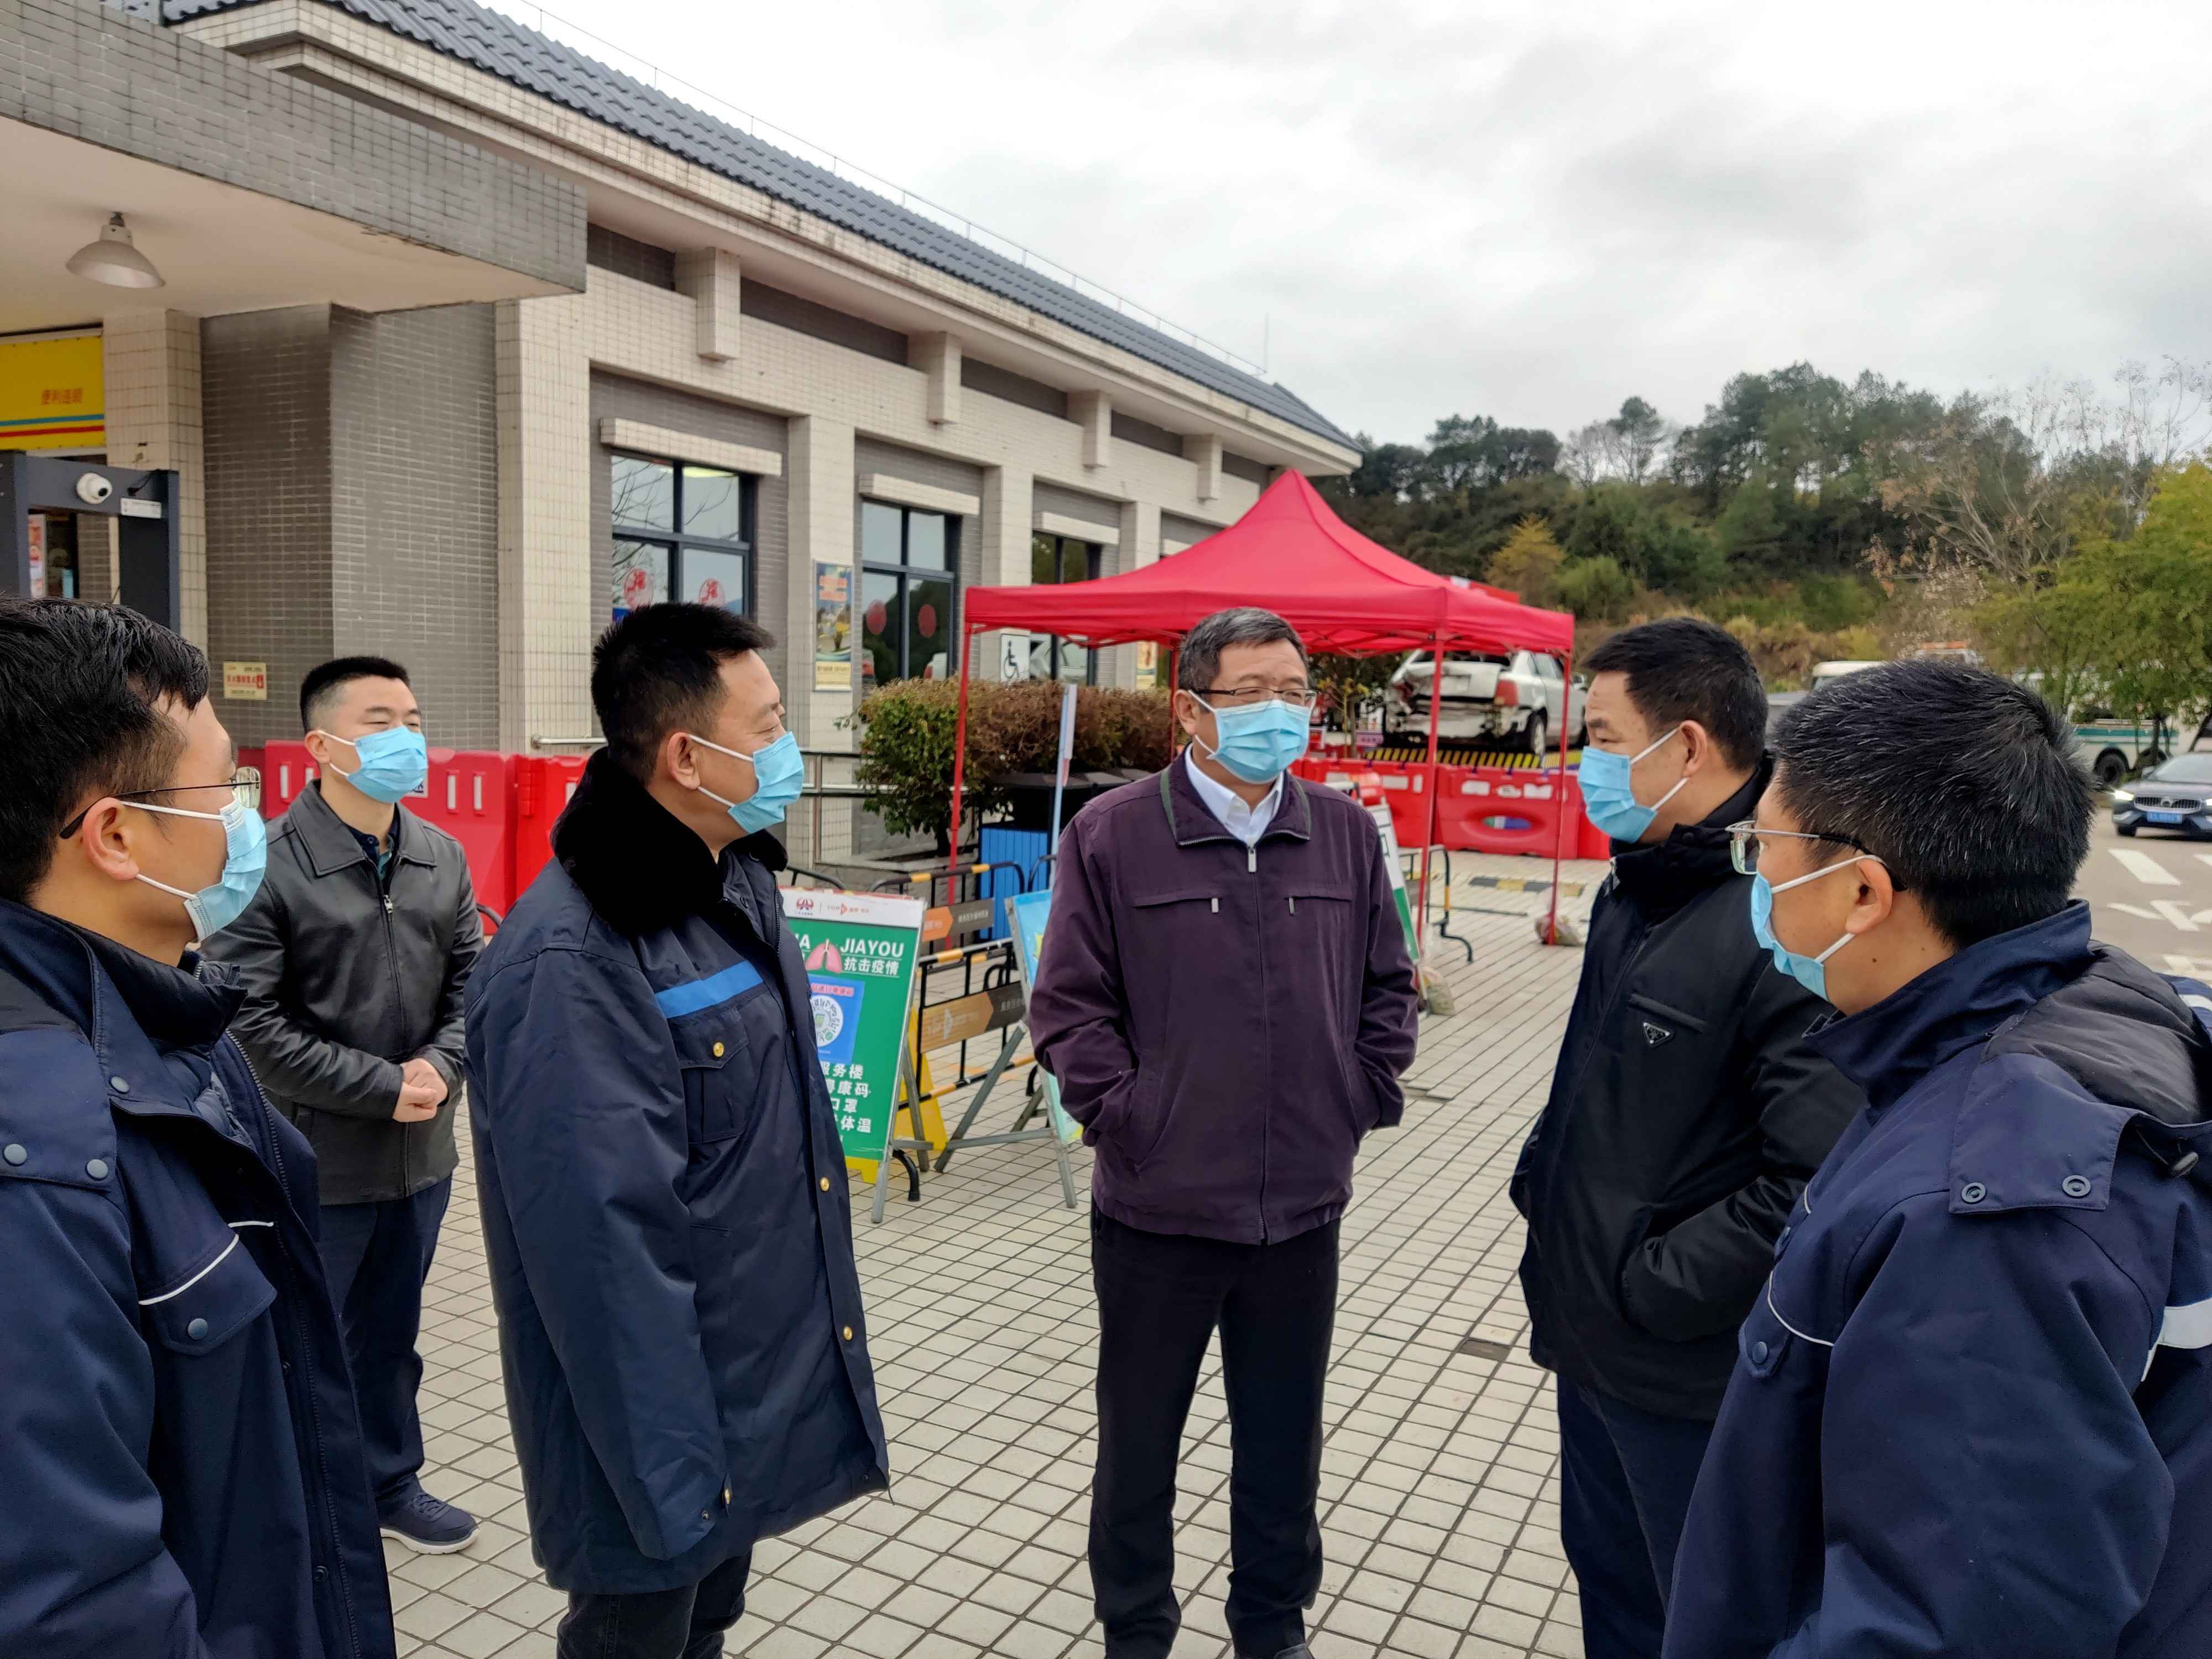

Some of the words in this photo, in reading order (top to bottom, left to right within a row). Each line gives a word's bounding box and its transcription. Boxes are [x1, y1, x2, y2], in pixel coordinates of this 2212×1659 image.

[795, 933, 810, 950] A
[840, 938, 904, 958] JIAYOU
[844, 957, 899, 975] 抗击疫情
[831, 1098, 858, 1113] 口罩
[834, 1114, 872, 1133] 体温
